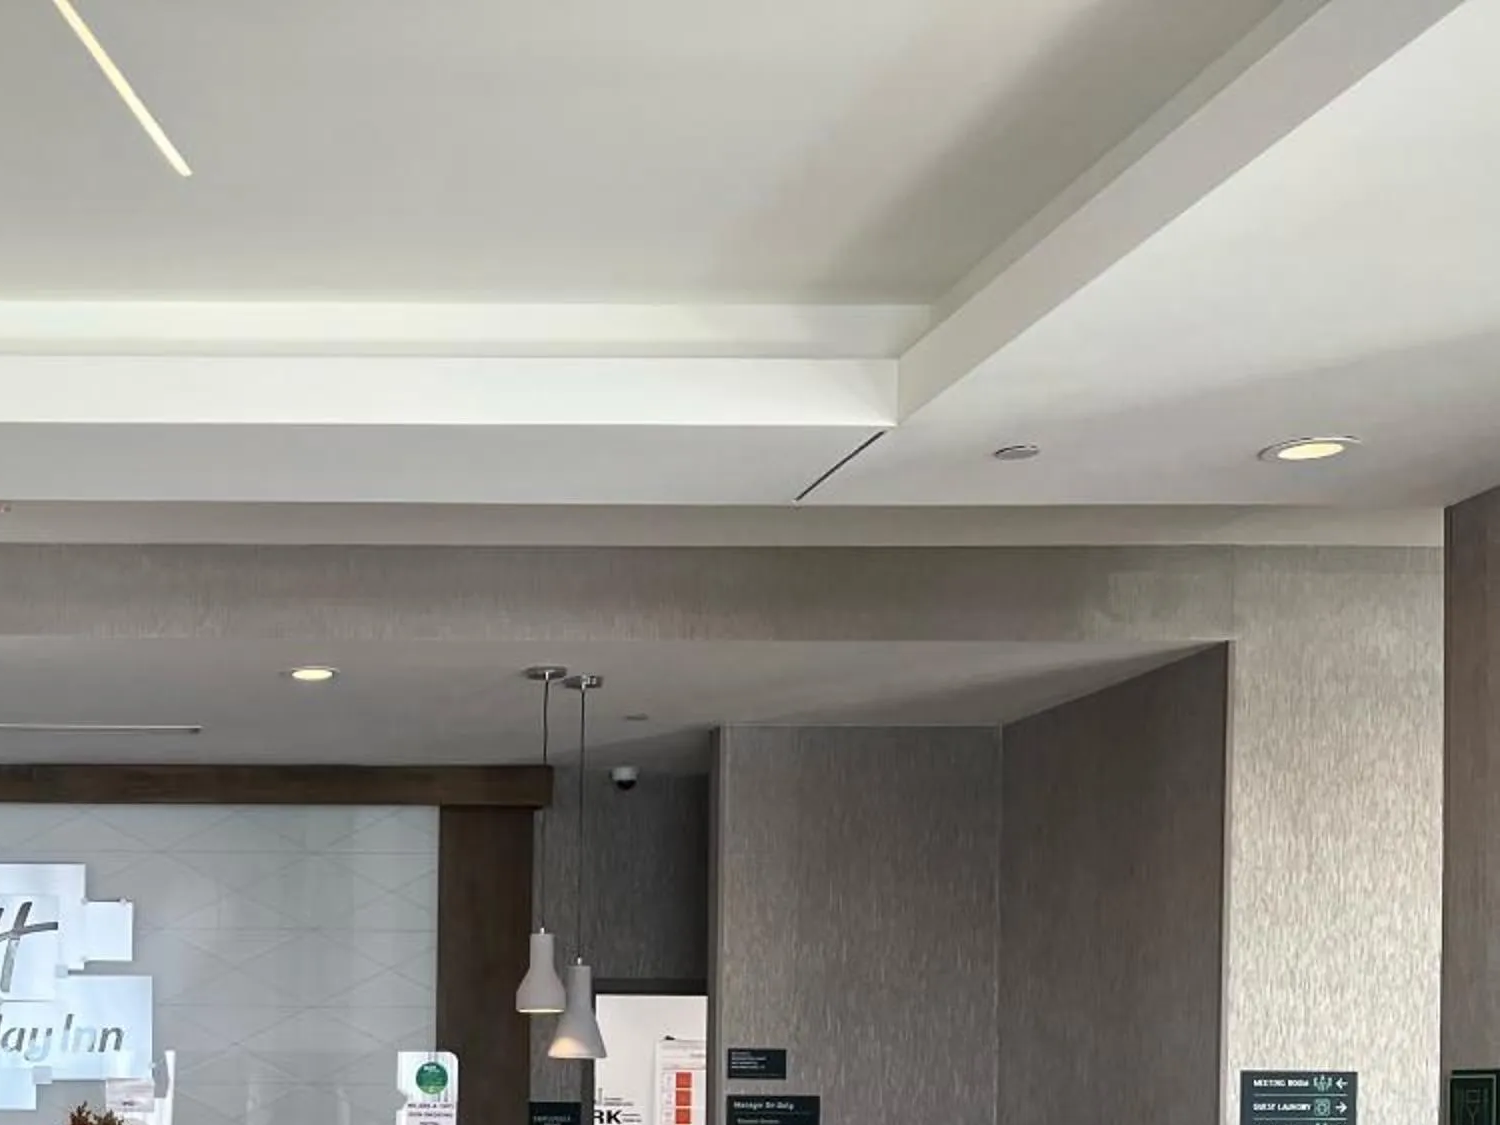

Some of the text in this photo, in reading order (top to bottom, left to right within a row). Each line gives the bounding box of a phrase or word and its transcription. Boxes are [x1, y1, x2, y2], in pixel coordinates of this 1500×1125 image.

[61, 1013, 124, 1053] Inn
[1253, 1079, 1309, 1087] MEETING ROOM
[1253, 1103, 1312, 1111] GUEST LAUNDRY
